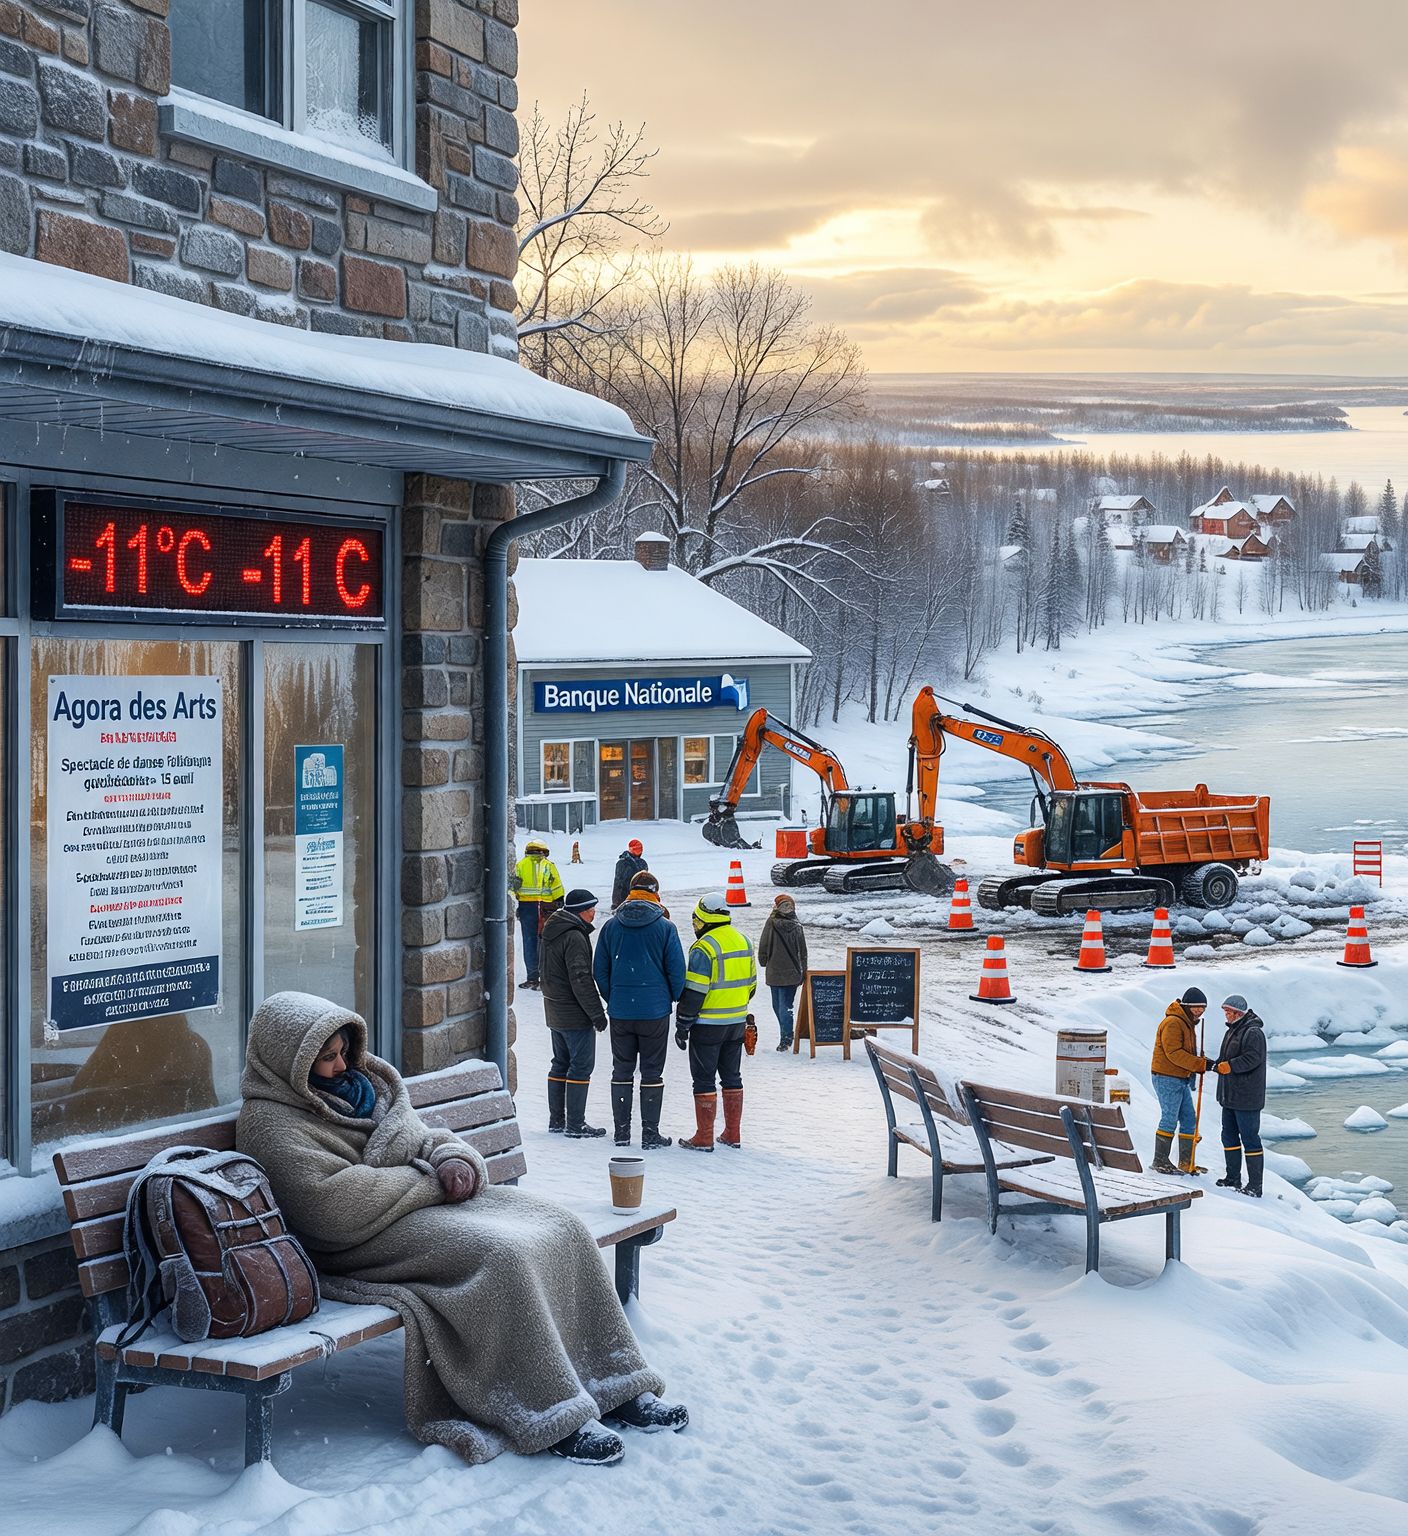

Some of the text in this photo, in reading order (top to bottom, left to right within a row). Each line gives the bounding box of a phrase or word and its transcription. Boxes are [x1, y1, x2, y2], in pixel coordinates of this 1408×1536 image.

[242, 535, 311, 605] -11
[336, 537, 371, 608] C
[53, 690, 217, 729] Agora des Arts
[544, 680, 712, 712] Banque Nationale
[61, 757, 115, 774] Spectacle
[117, 756, 130, 769] de
